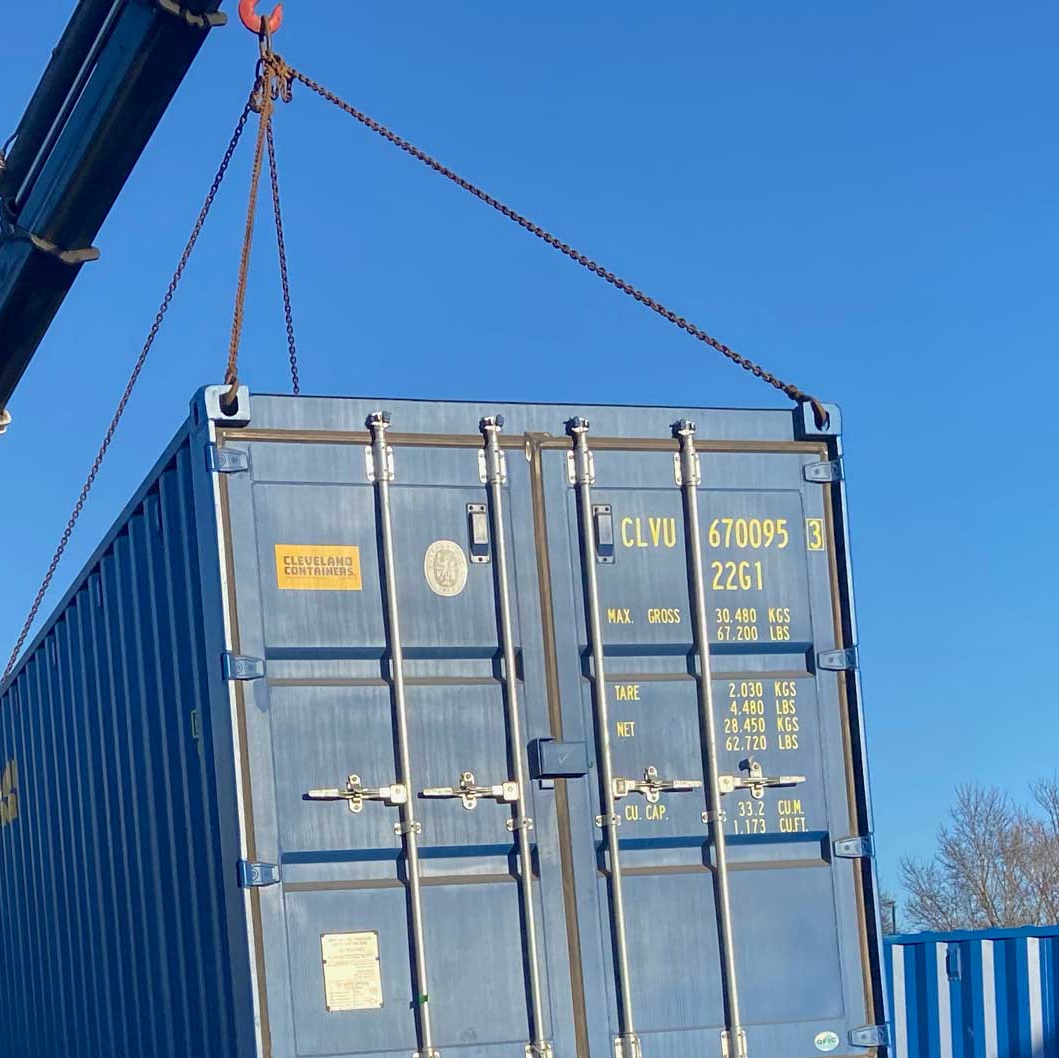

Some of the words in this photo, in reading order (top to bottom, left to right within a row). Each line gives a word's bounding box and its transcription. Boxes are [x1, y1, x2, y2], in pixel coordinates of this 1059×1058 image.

[621, 517, 677, 548] CLVU
[708, 518, 789, 549] 670095
[807, 519, 824, 550] 3
[283, 555, 353, 567] CLEVELAND
[711, 560, 763, 590] 22G1
[607, 609, 635, 624] MAX.
[648, 608, 681, 624] GROSS
[715, 608, 757, 624] 30.480
[768, 608, 791, 624] KGS
[717, 626, 758, 641] 67.200
[770, 626, 790, 641] LBS
[614, 685, 640, 700] TARE
[729, 682, 763, 698] 2.030
[774, 682, 797, 697] KGS
[730, 700, 764, 715] 4.480
[776, 699, 796, 714] LBS
[616, 721, 635, 737] NET
[724, 718, 765, 733] 28.450
[777, 717, 799, 732] KGS
[725, 735, 767, 751] 62.720
[778, 735, 799, 749] LBS
[625, 805, 642, 820] CU.
[645, 804, 669, 820] CAP.
[738, 802, 765, 817] 33.2
